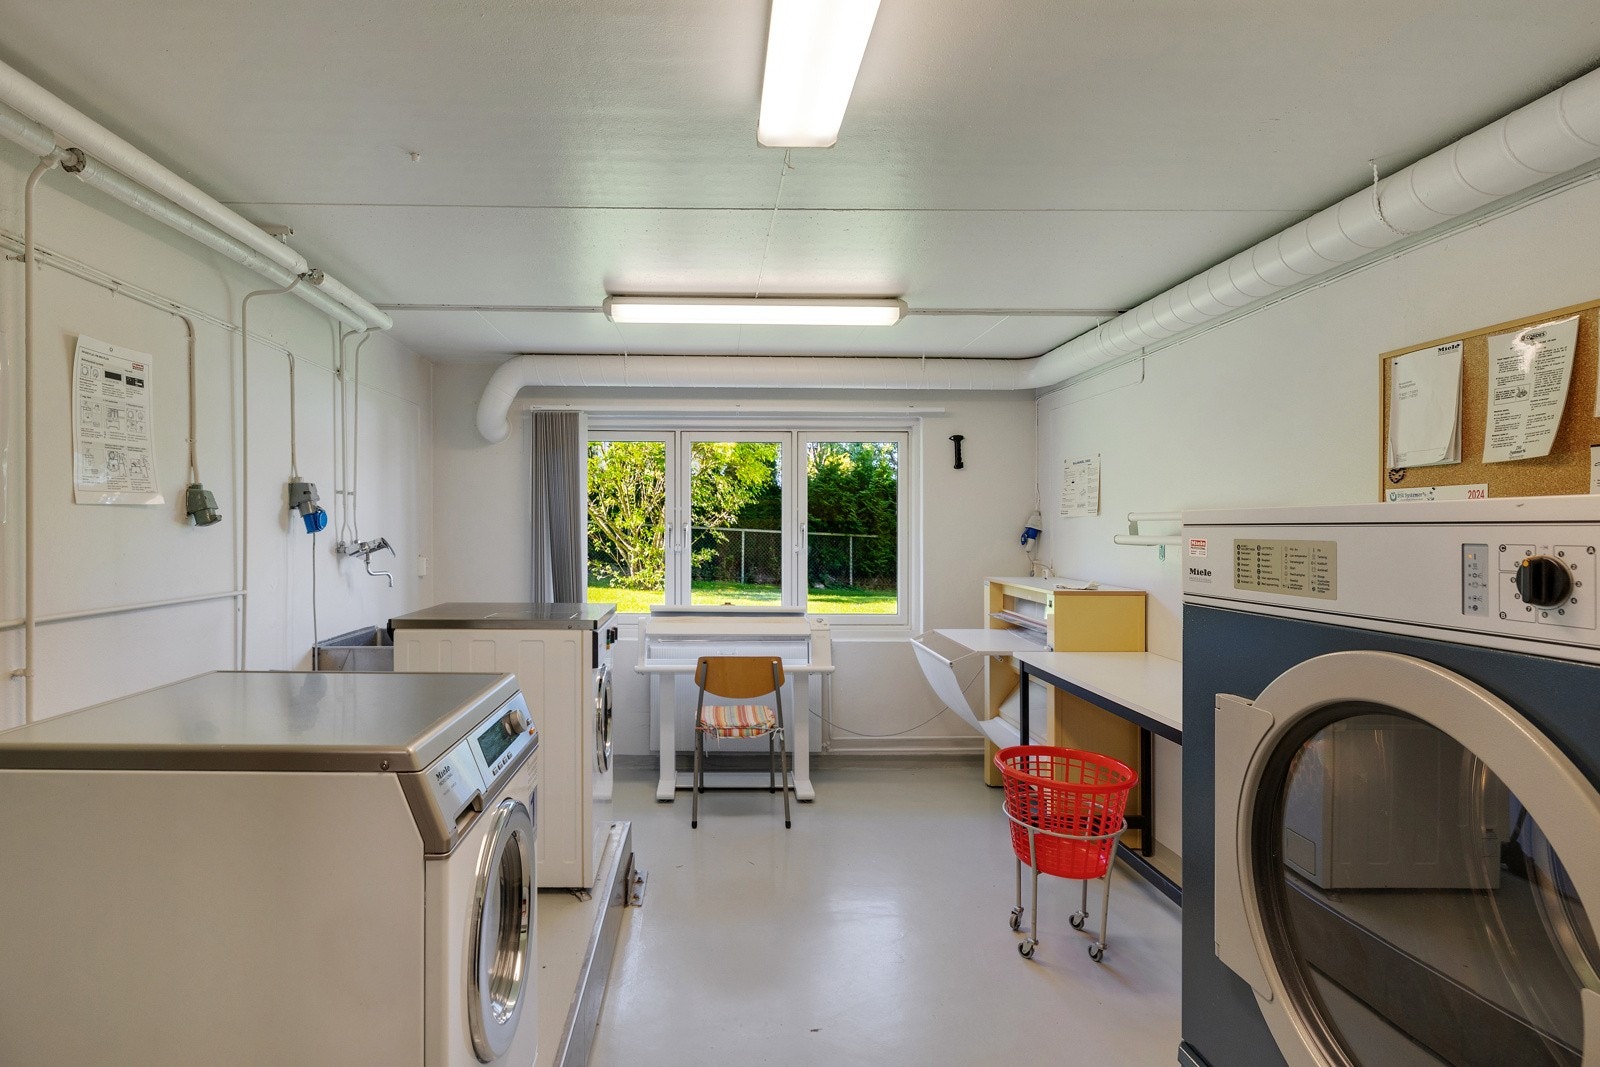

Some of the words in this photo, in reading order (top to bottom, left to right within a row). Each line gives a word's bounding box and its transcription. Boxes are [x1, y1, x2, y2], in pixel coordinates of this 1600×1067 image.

[1437, 343, 1460, 353] Miele
[1467, 489, 1485, 499] 2024
[1189, 567, 1212, 577] Miele
[435, 765, 451, 781] Miele
